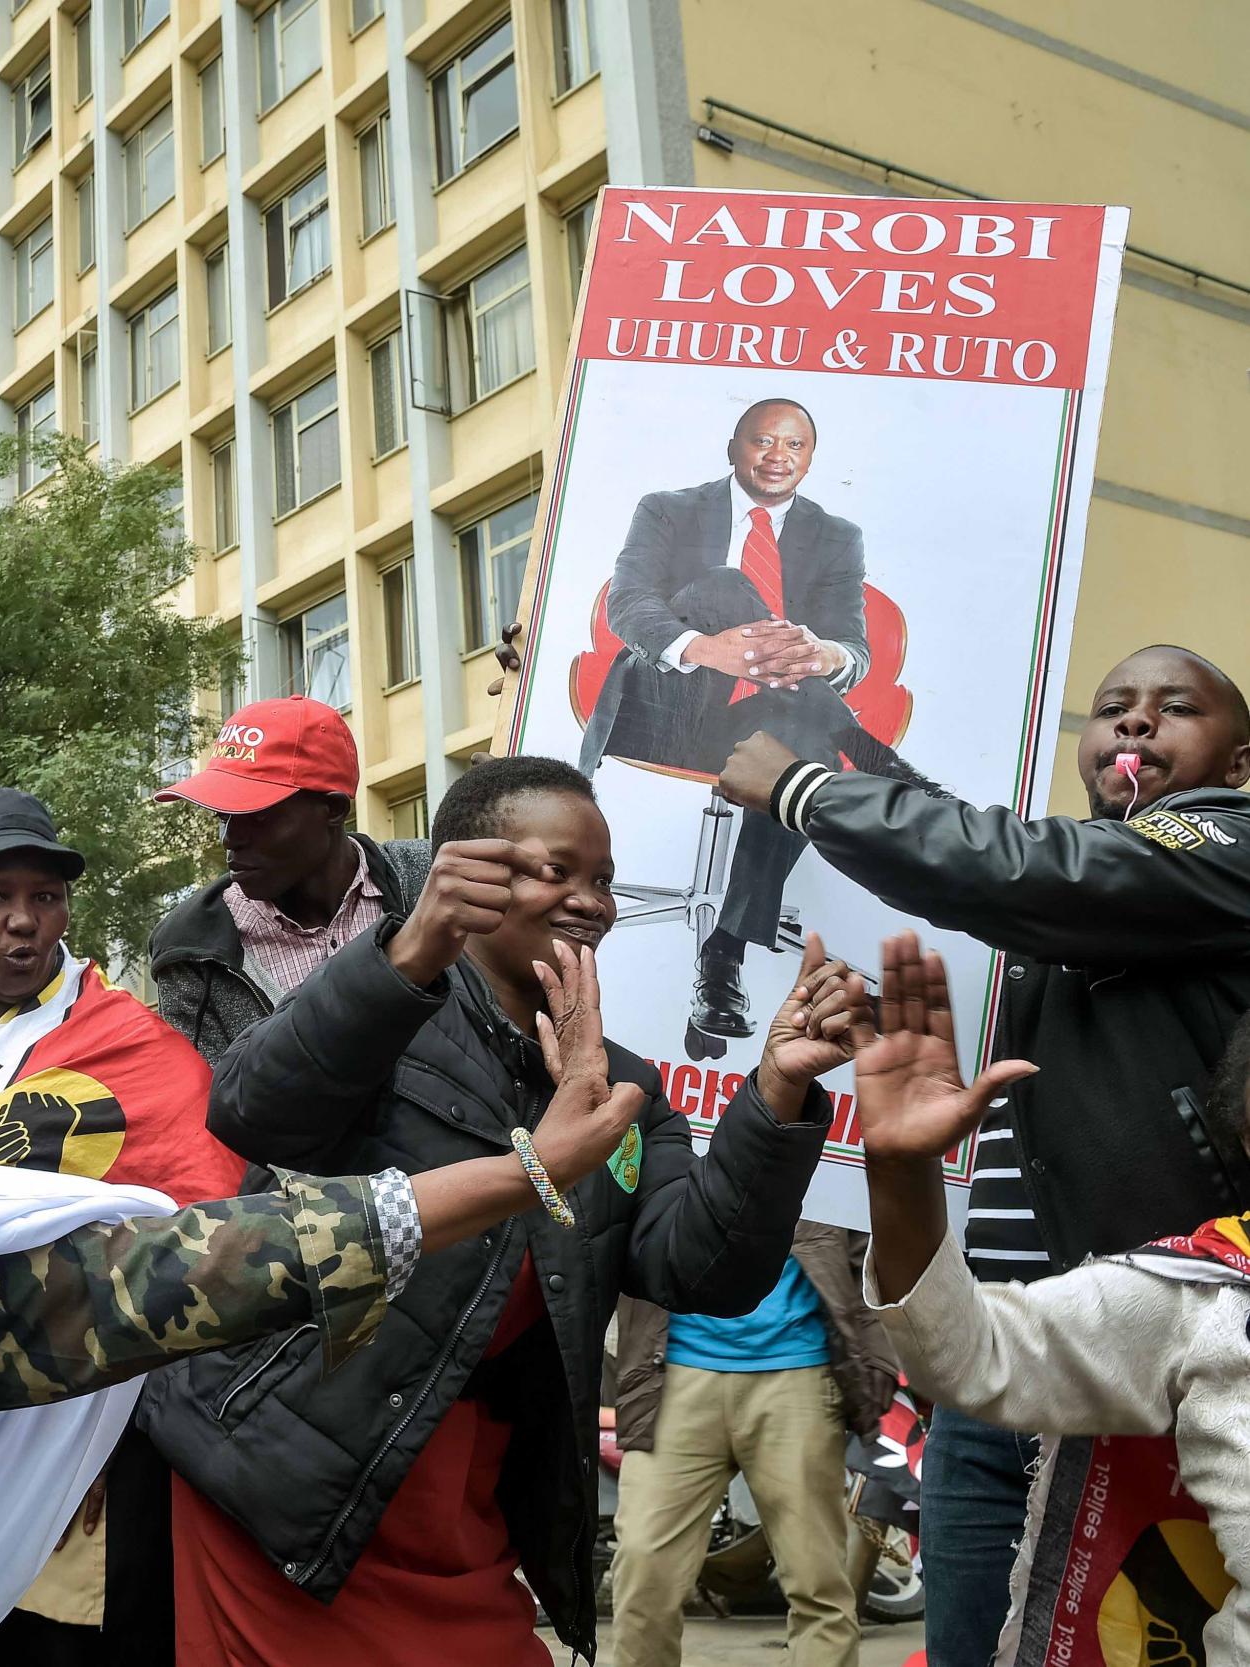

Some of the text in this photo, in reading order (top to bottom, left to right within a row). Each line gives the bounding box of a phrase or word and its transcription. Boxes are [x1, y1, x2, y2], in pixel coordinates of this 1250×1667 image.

[615, 201, 1063, 260] NAIROBI
[653, 259, 997, 318] LOVES
[606, 317, 1057, 382] UHURU & RUTO
[1145, 813, 1197, 844] FUBU
